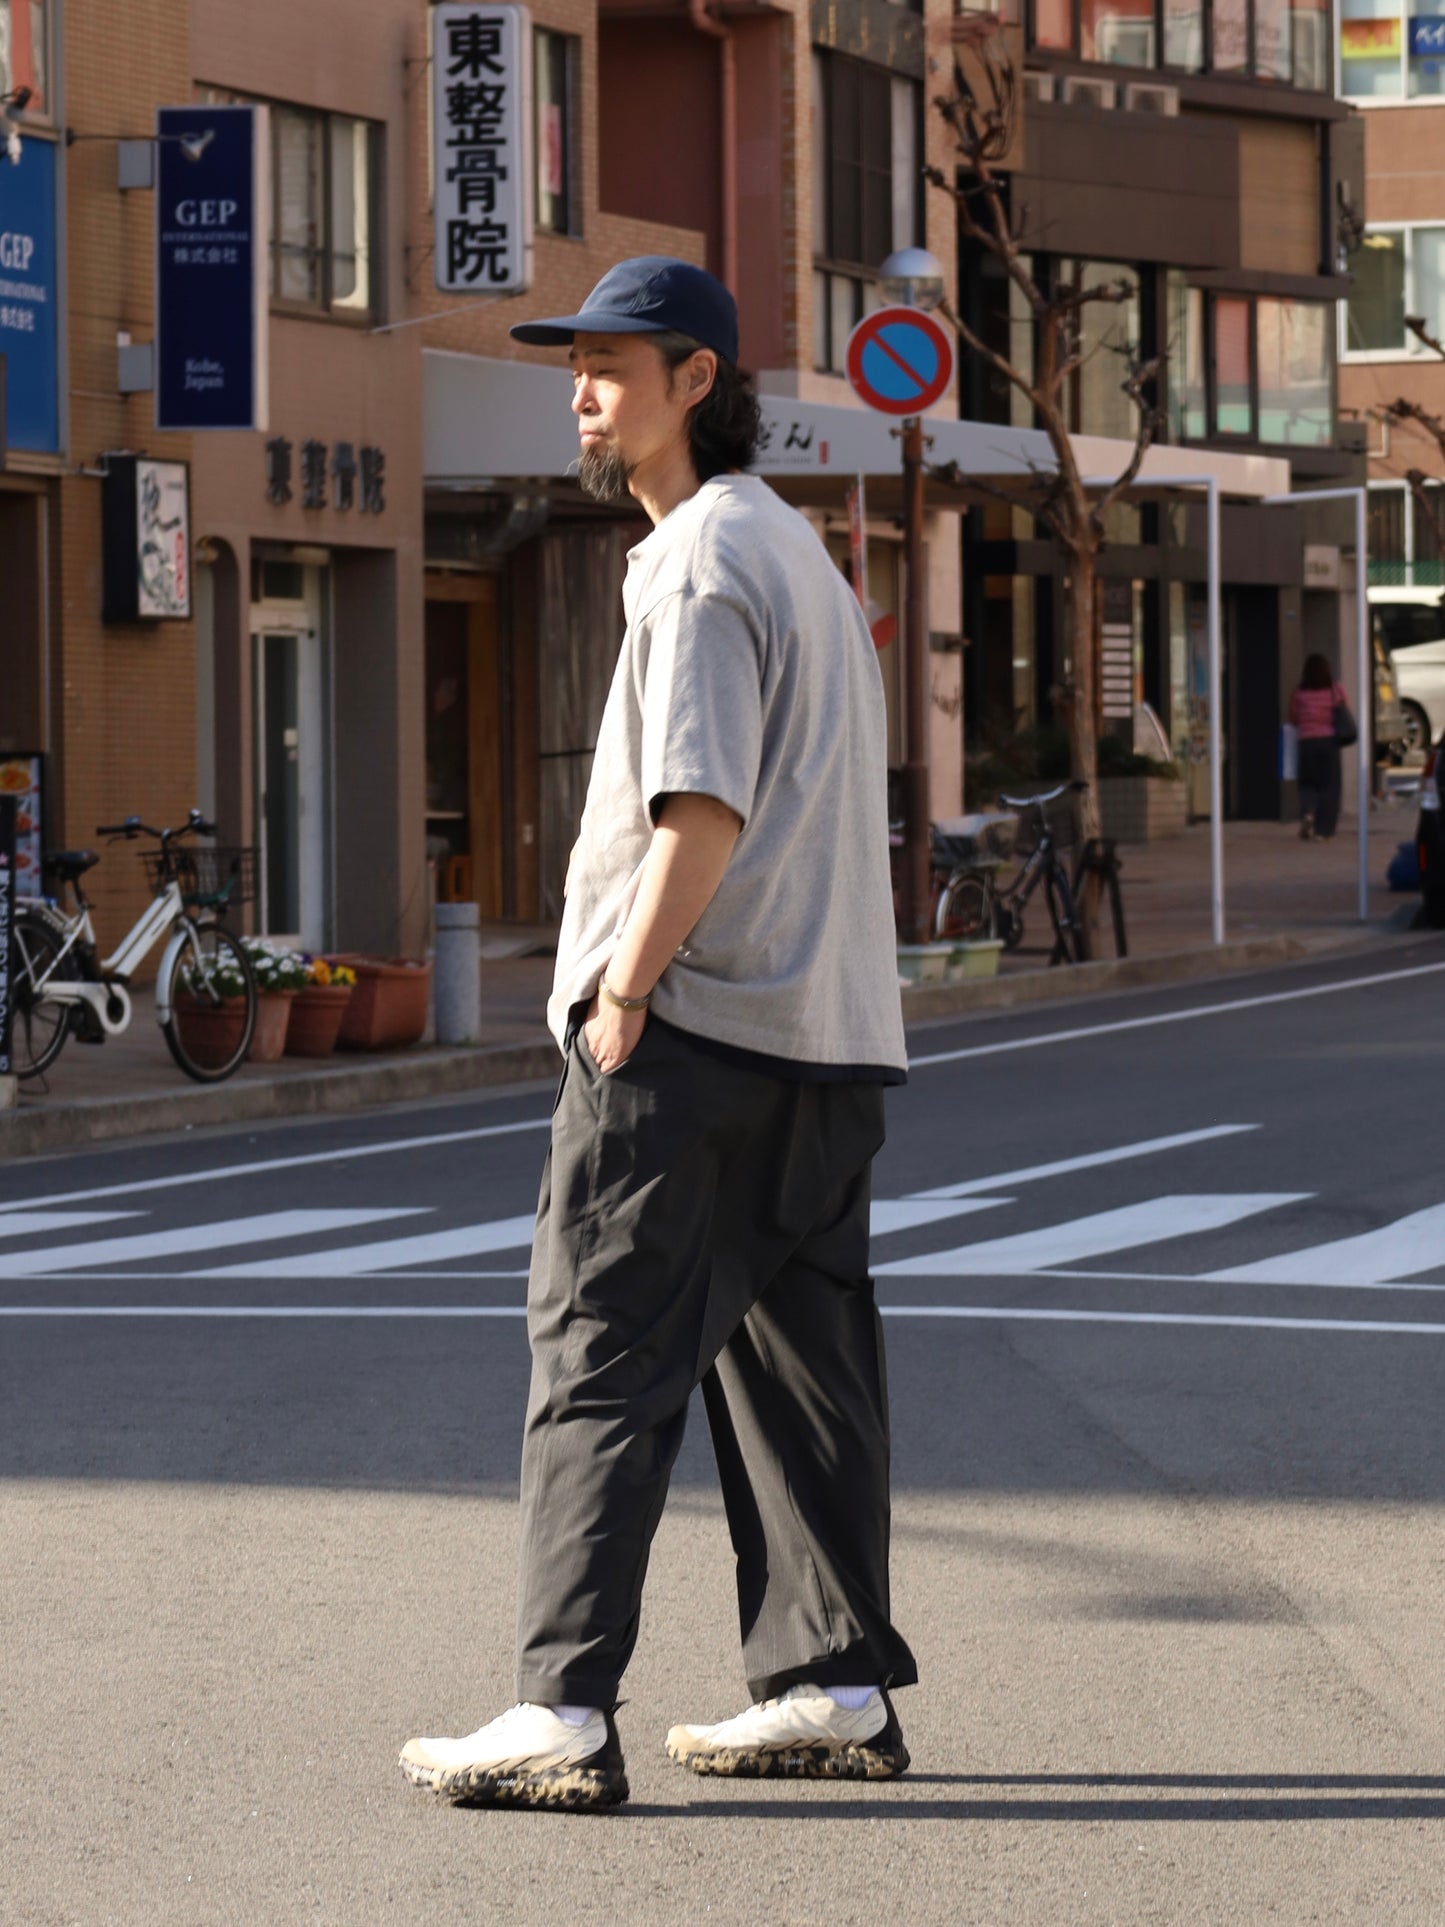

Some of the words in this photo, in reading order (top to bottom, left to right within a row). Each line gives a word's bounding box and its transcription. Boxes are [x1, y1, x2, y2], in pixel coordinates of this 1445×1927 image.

[445, 14, 509, 284] 東整骨院
[175, 199, 237, 225] GEP
[0, 231, 34, 271] GEP
